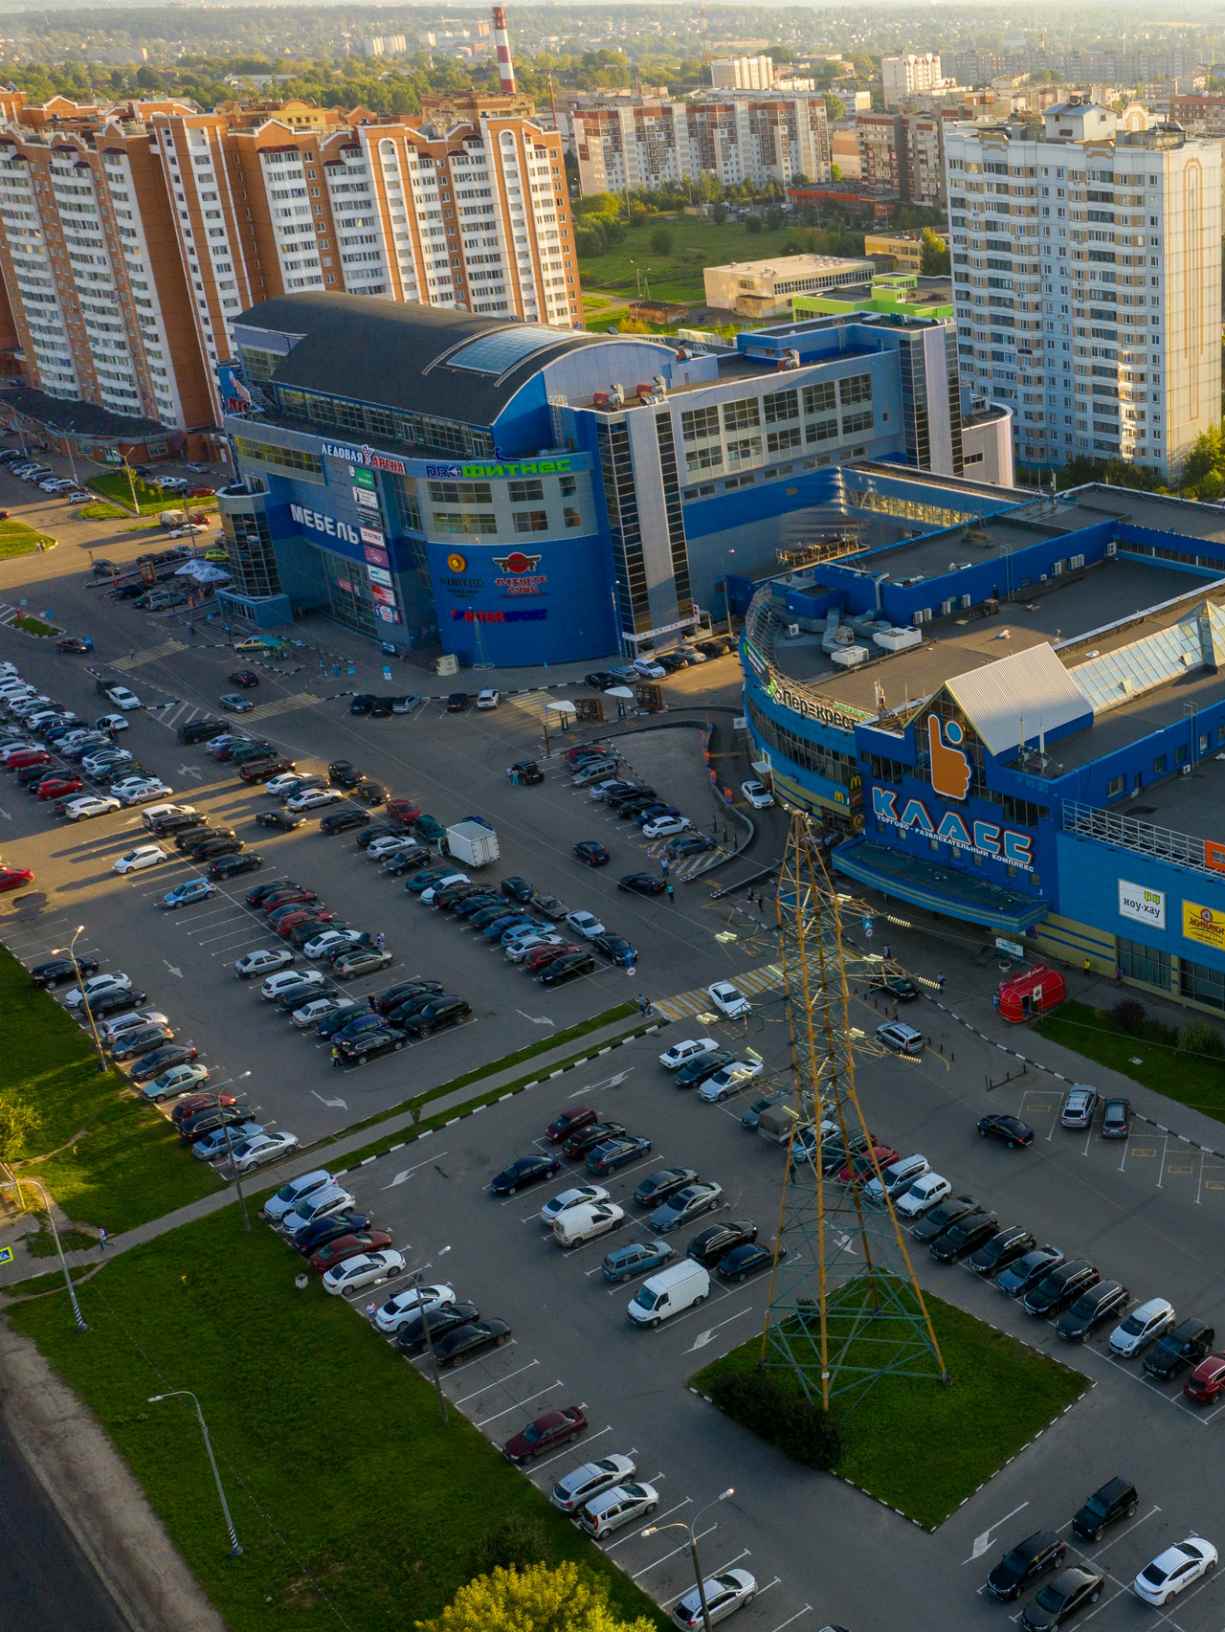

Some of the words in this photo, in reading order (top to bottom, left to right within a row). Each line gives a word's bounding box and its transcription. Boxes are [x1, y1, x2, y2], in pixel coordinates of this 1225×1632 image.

[463, 460, 571, 479] ФИТНЕС
[290, 504, 359, 544] МЕБЕЛЬ
[872, 786, 1033, 864] КЛАСС
